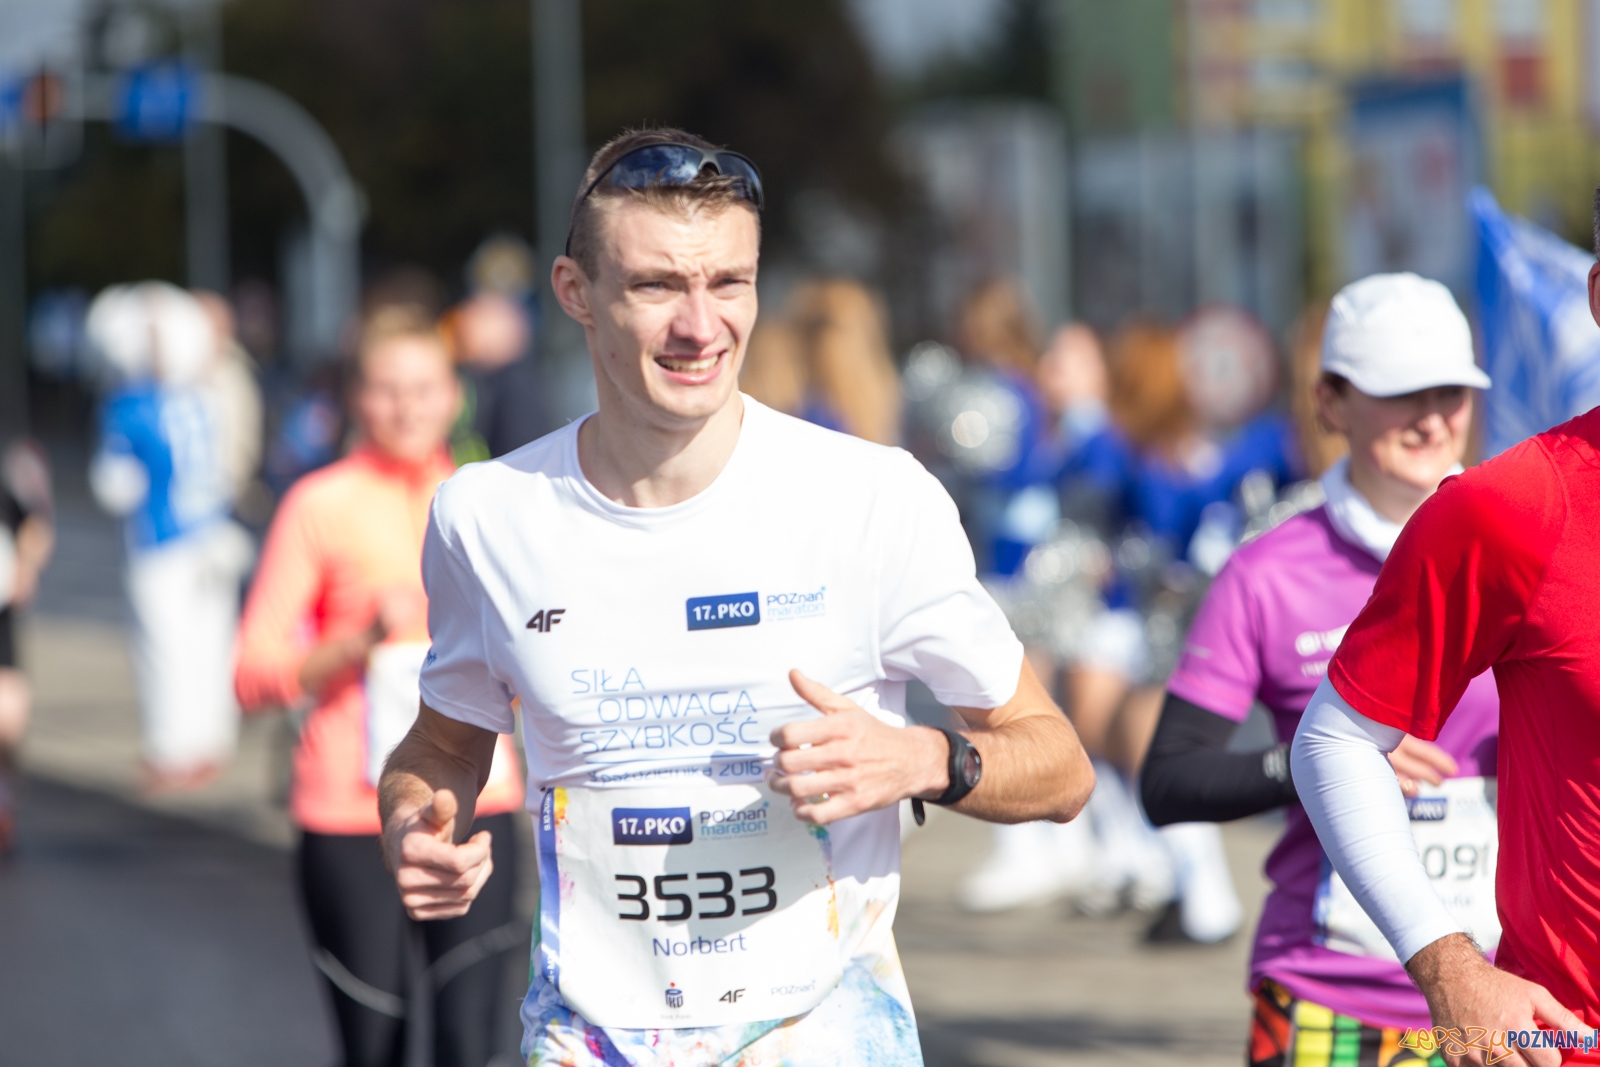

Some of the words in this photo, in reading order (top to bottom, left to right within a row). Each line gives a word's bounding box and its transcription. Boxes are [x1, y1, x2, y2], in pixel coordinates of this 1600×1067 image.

[526, 609, 566, 632] 4F
[767, 602, 825, 617] maraton
[571, 667, 646, 694] SIŁA
[598, 690, 758, 723] ODWAGA
[580, 716, 760, 755] SZYBKOŚĆ
[719, 760, 762, 778] 2016
[701, 819, 768, 836] maraton
[614, 866, 778, 922] 3533
[652, 933, 748, 957] Norbert
[718, 988, 747, 1003] 4F
